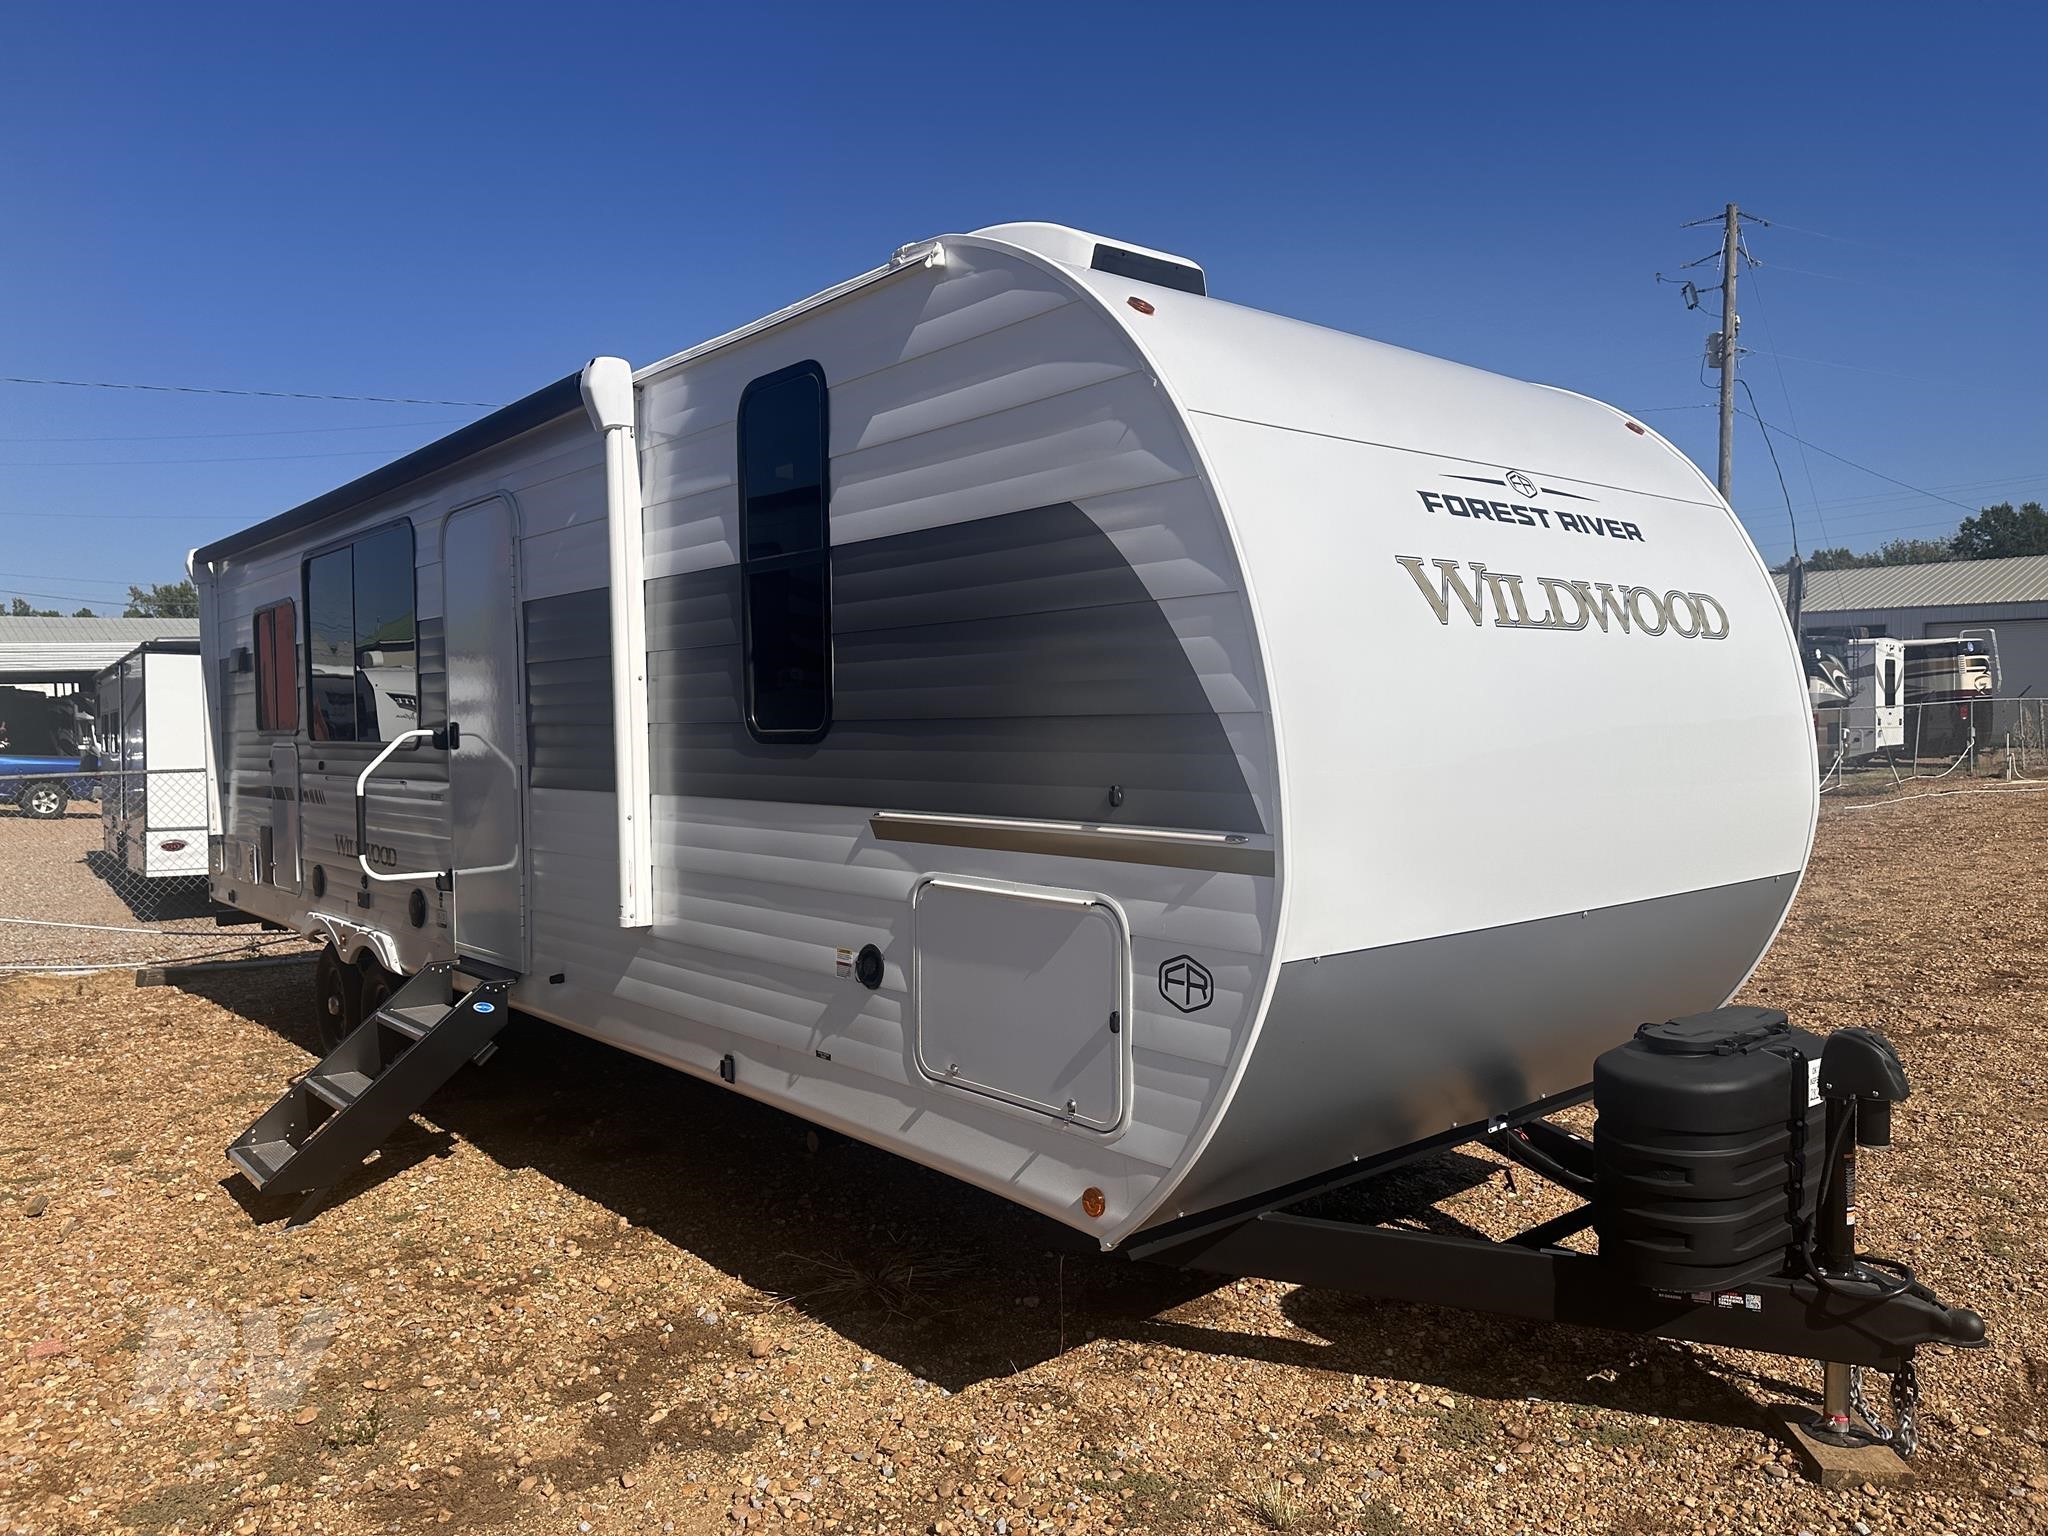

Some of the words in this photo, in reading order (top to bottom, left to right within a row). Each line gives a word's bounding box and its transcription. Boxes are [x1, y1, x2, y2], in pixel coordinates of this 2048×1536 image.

[1416, 490, 1550, 529] FOREST
[1555, 510, 1646, 542] RIVER
[1395, 555, 1731, 640] WILDWOOD
[334, 833, 397, 867] WILWOOD
